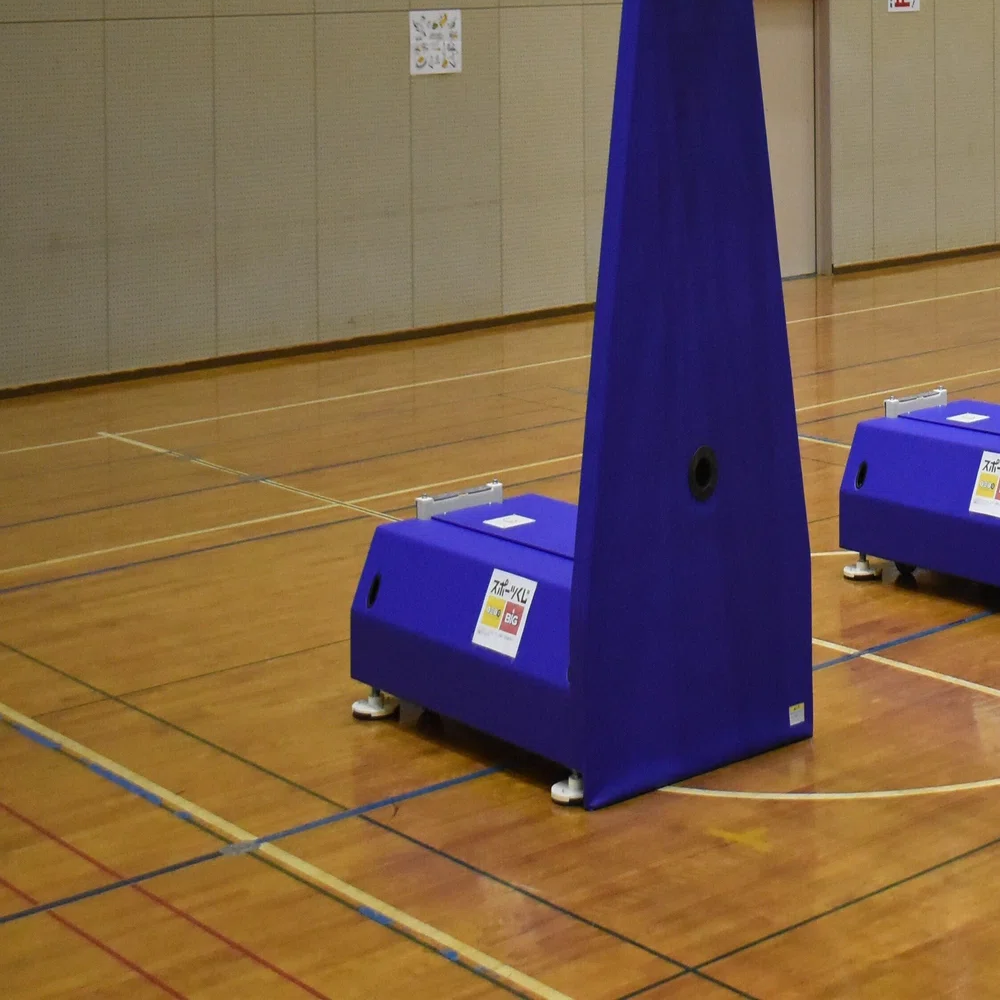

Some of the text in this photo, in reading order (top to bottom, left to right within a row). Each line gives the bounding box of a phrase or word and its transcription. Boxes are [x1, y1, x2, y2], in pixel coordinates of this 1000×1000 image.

[491, 579, 530, 604] スポーツくじ
[504, 611, 519, 626] BIG
